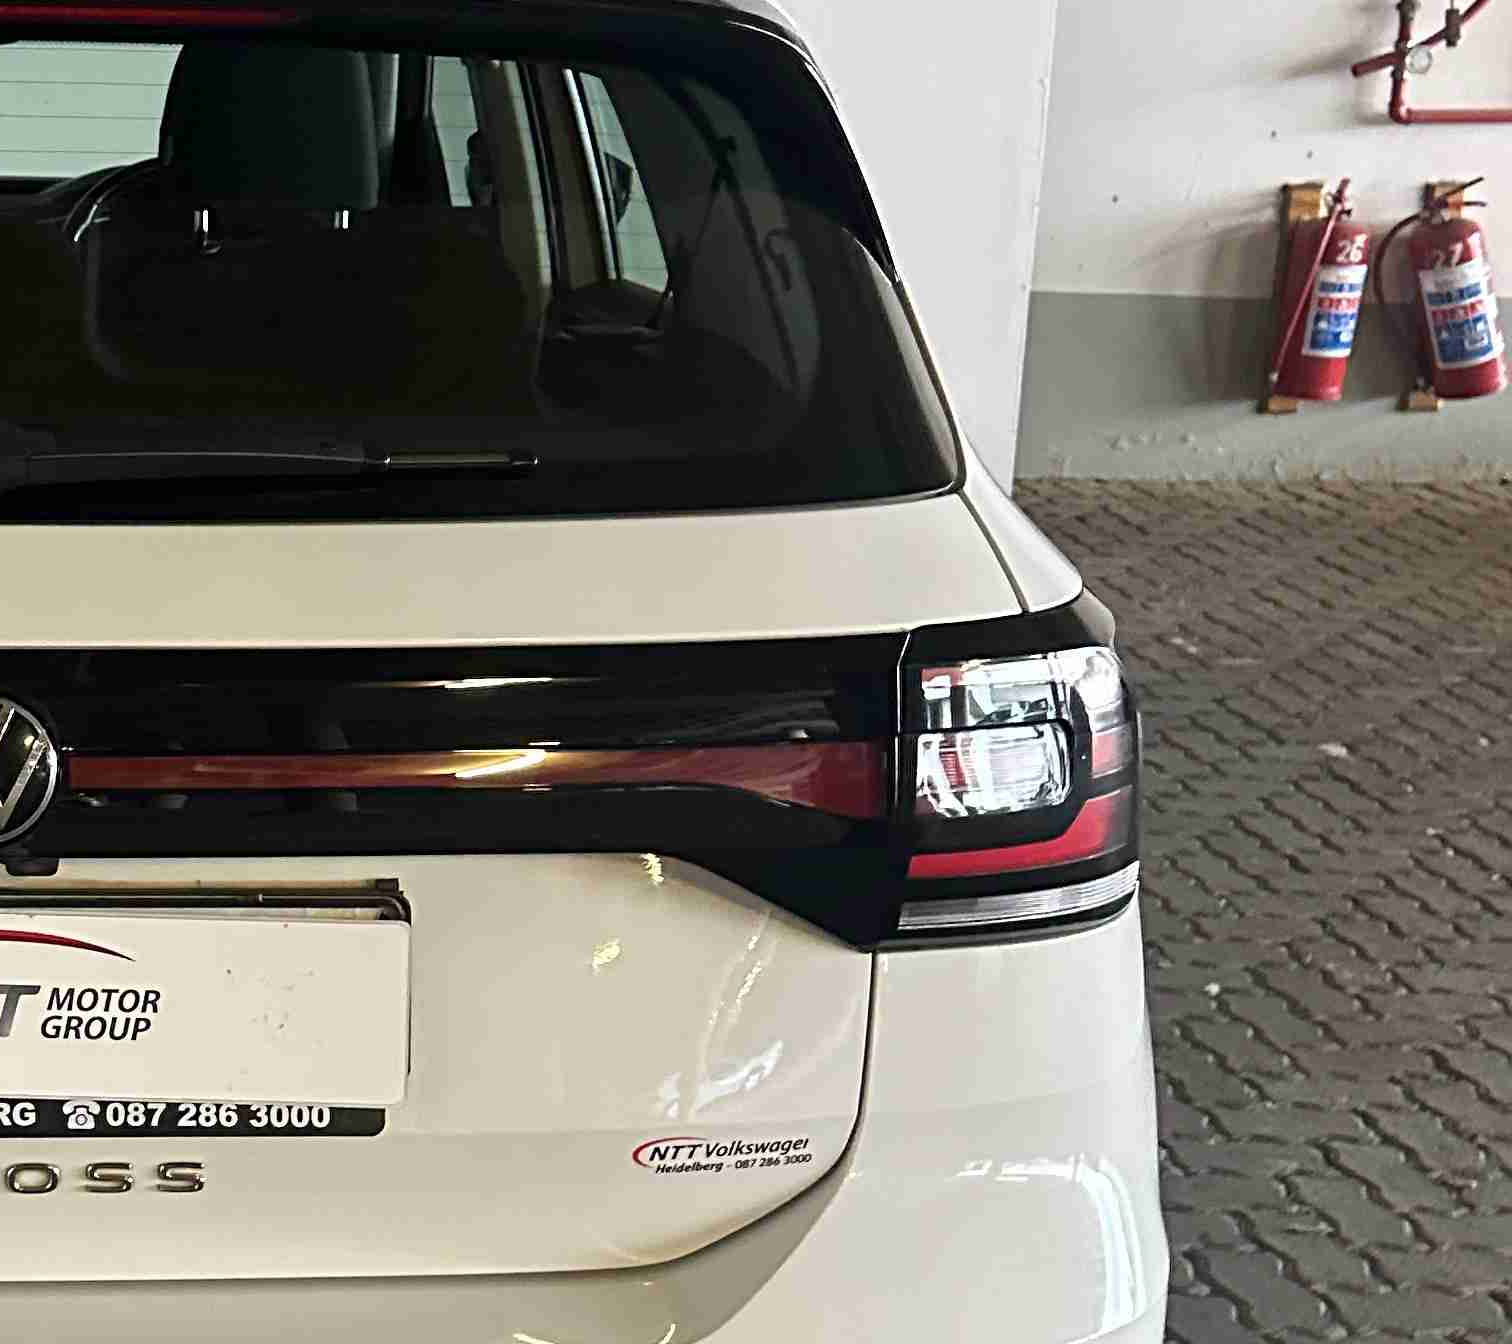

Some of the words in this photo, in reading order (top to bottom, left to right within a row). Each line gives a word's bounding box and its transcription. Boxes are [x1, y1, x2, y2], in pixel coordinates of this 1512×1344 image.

[1336, 234, 1368, 263] 26
[46, 987, 161, 1013] MOTOR
[40, 1015, 152, 1041] GROUP
[106, 1103, 167, 1127] 087
[177, 1104, 238, 1127] 286
[249, 1105, 330, 1128] 3000
[649, 1143, 703, 1161] NTT
[655, 1161, 723, 1174] Heidelberg
[734, 1159, 757, 1170] 087
[758, 1156, 781, 1167] 286
[783, 1153, 812, 1164] 3000
